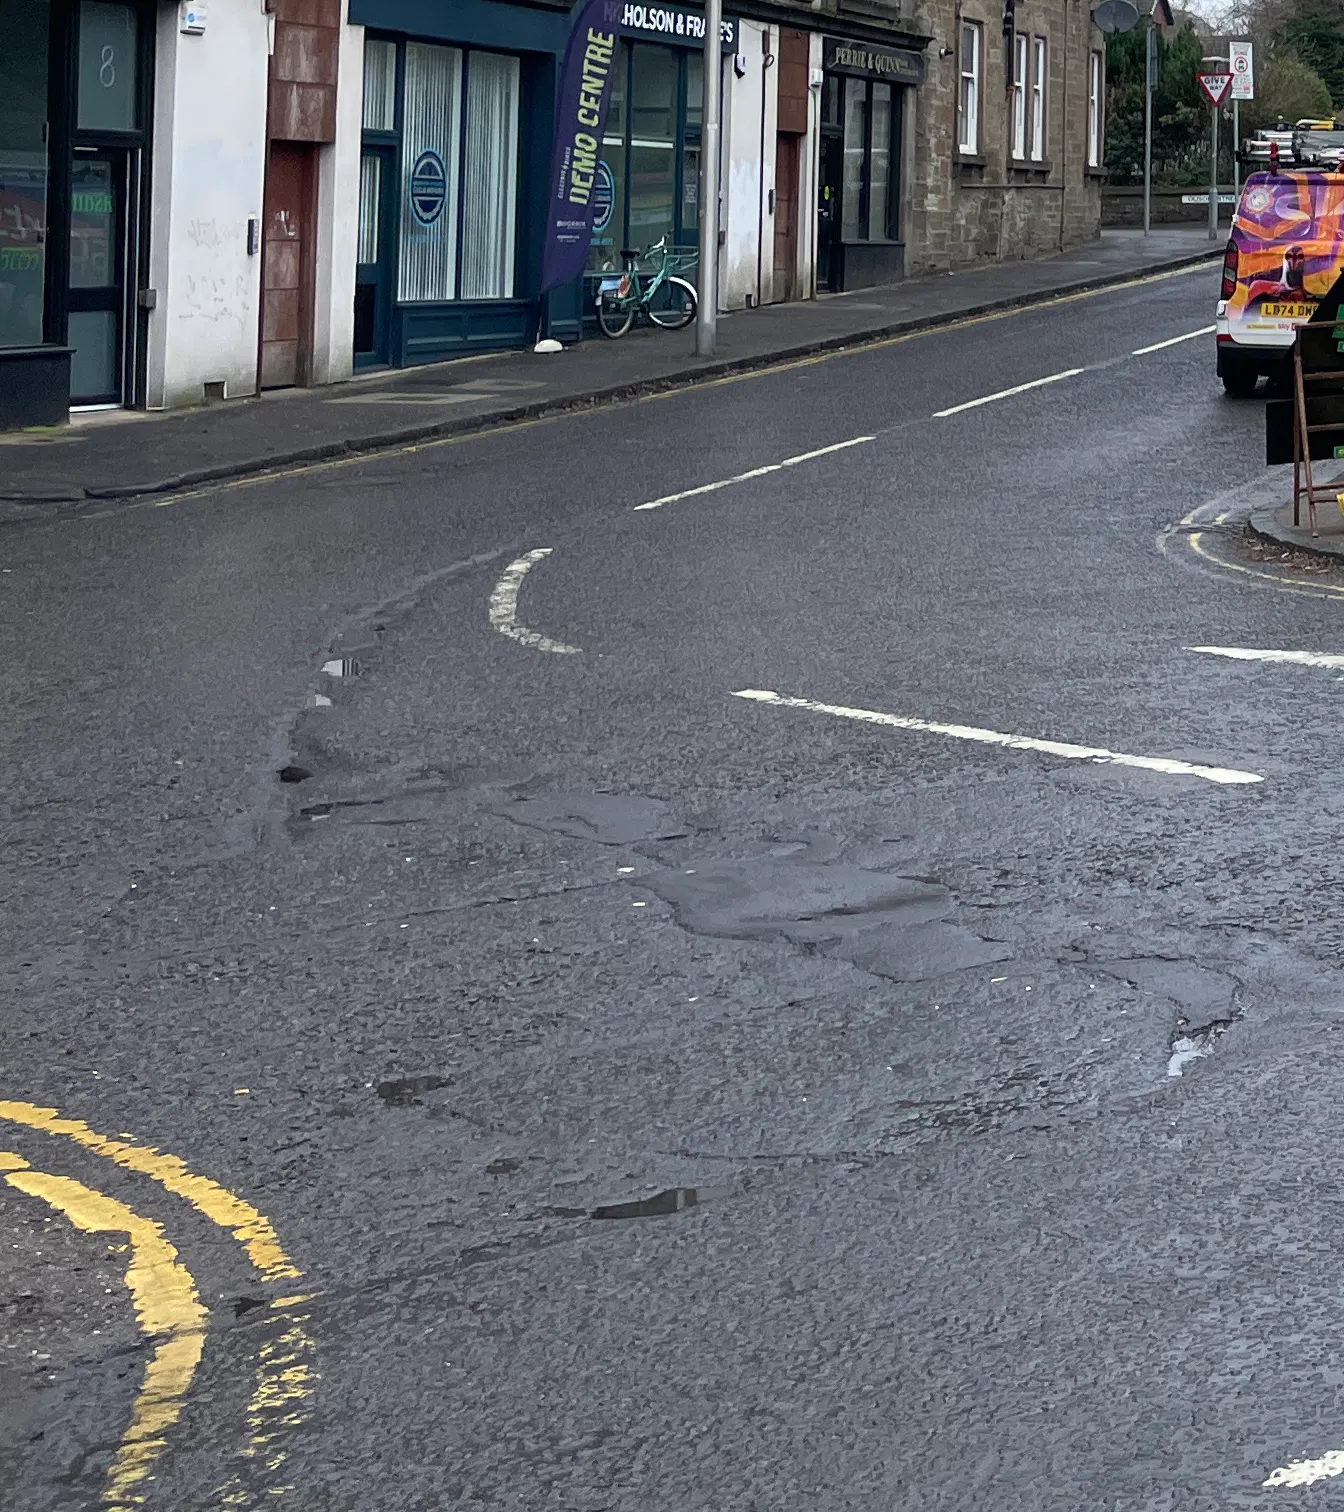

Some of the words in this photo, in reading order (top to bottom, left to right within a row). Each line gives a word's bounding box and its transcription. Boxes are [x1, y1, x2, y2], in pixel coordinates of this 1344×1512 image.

[675, 13, 685, 35] &
[99, 44, 116, 88] 8
[577, 27, 615, 128] CENTRE
[835, 47, 867, 69] PERRIE
[867, 52, 874, 69] &
[874, 53, 901, 74] QUINN
[1204, 77, 1225, 85] GIVE
[569, 132, 598, 206] DEMO
